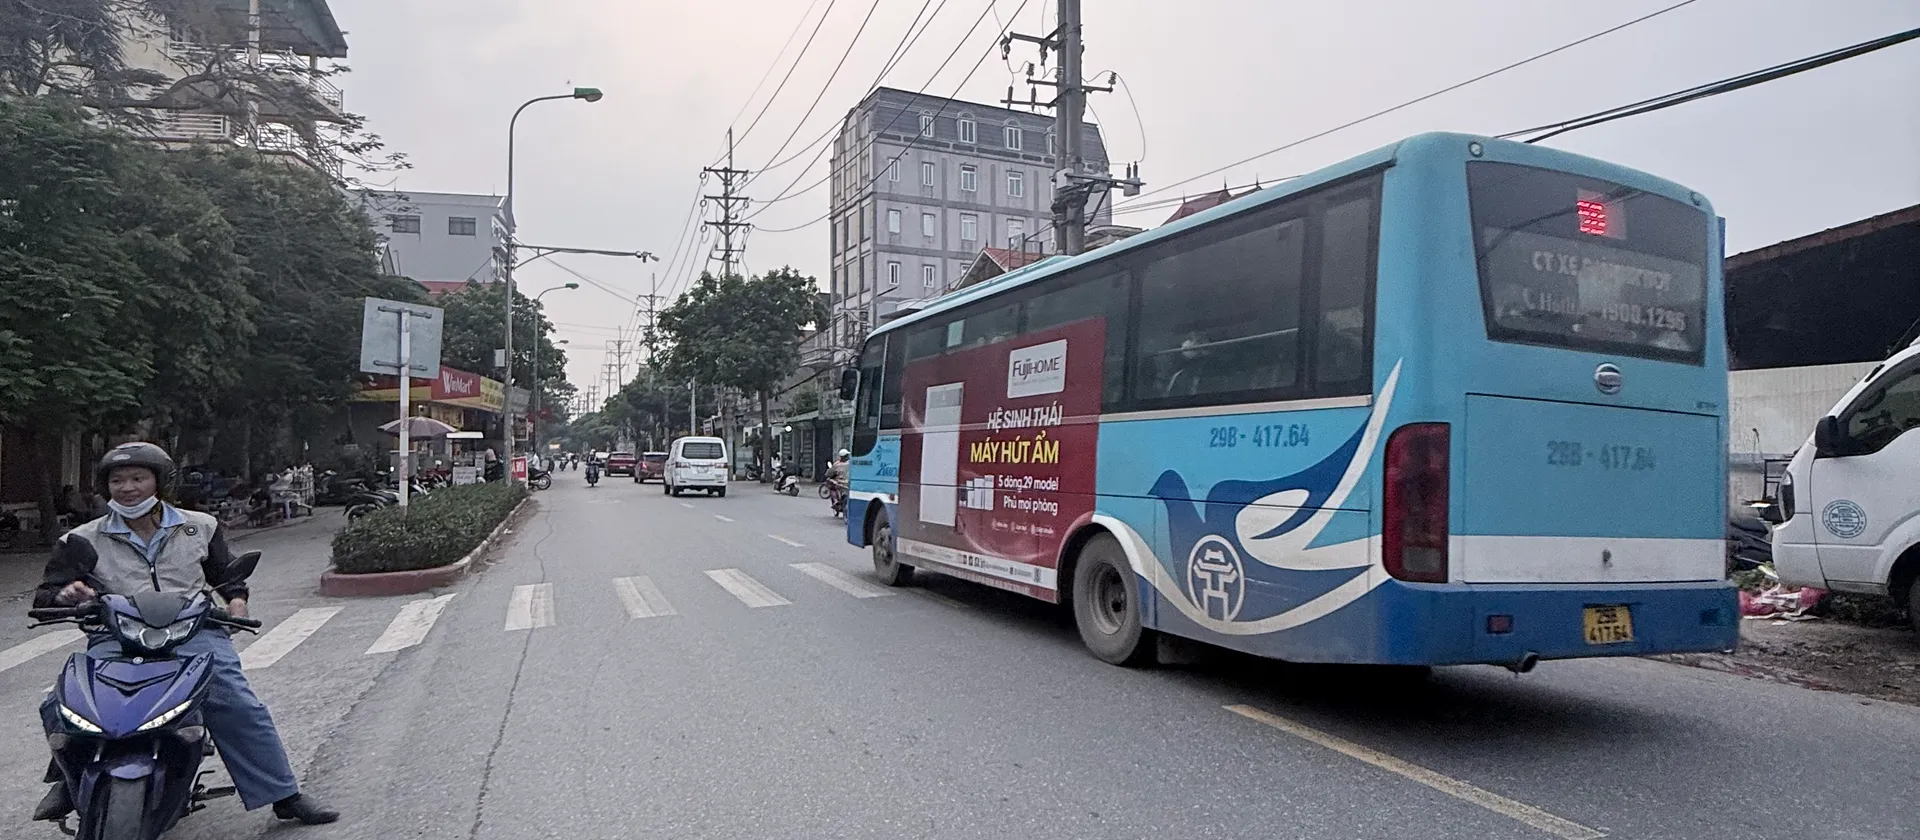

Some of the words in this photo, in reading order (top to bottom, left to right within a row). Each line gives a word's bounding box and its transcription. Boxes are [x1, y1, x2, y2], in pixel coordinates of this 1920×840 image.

[987, 407, 1003, 433] HỆ
[1003, 408, 1032, 429] SINH
[1034, 400, 1063, 427] THÁI
[970, 437, 999, 462] MÁY
[1001, 436, 1030, 463] HÚT
[1031, 430, 1059, 464] ẨM
[1209, 426, 1238, 448] 29B
[1252, 423, 1310, 447] 417.64
[998, 475, 1004, 488] 5
[1034, 476, 1060, 491] model
[1018, 497, 1032, 514] mọi
[1032, 498, 1058, 516] phòng
